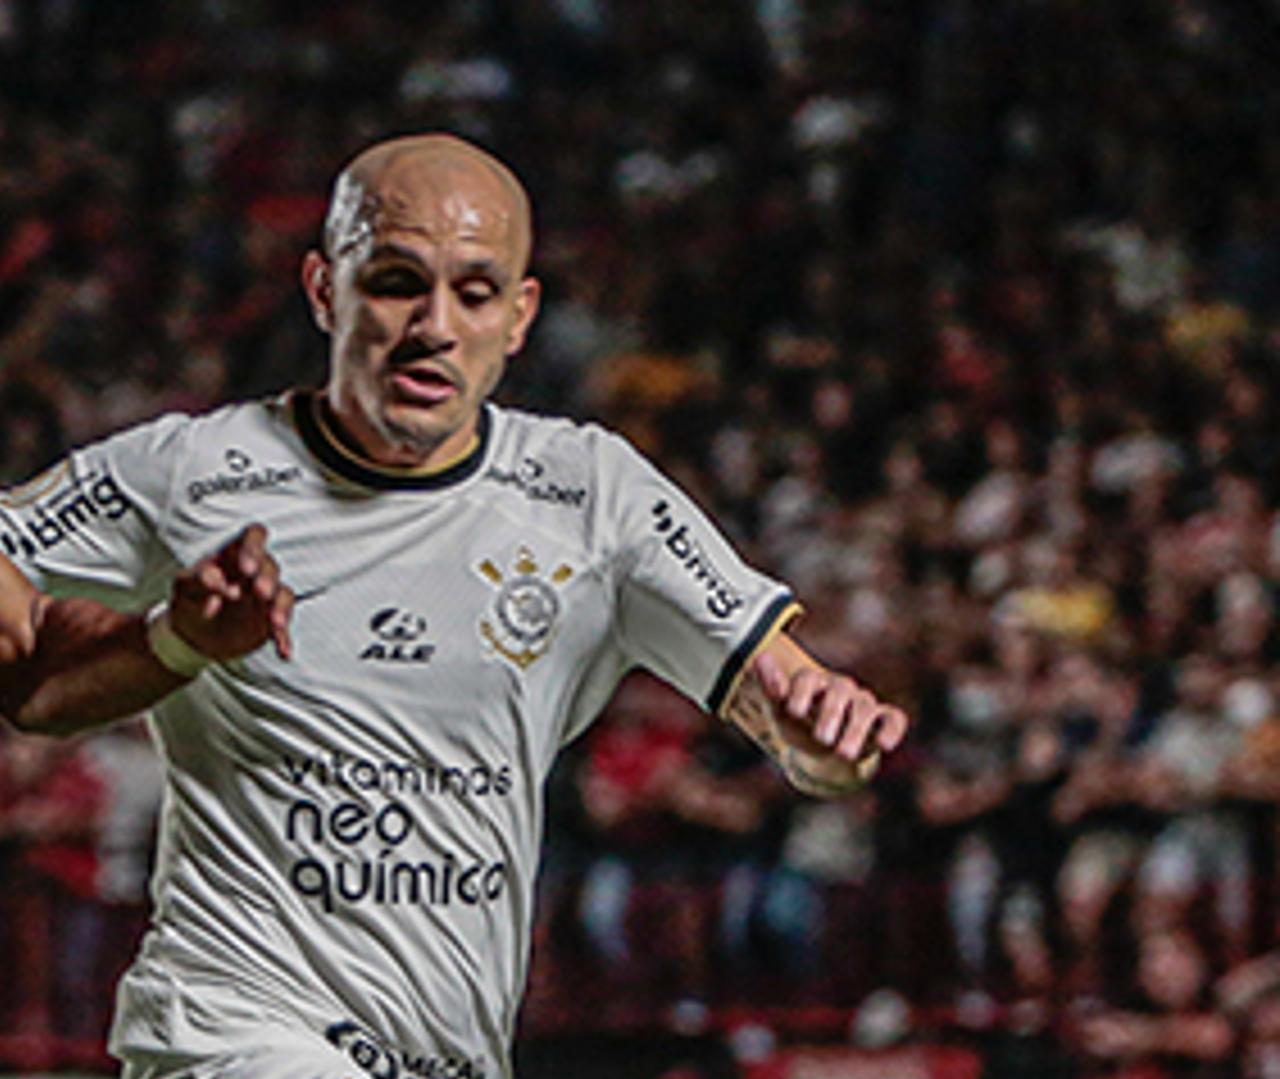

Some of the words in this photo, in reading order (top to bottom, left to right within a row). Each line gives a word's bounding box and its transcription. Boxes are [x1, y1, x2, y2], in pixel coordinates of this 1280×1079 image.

[28, 473, 132, 551] bmg
[665, 525, 743, 619] bmg
[357, 645, 436, 663] ALE
[284, 750, 514, 797] vitaminas
[286, 801, 413, 846] neo
